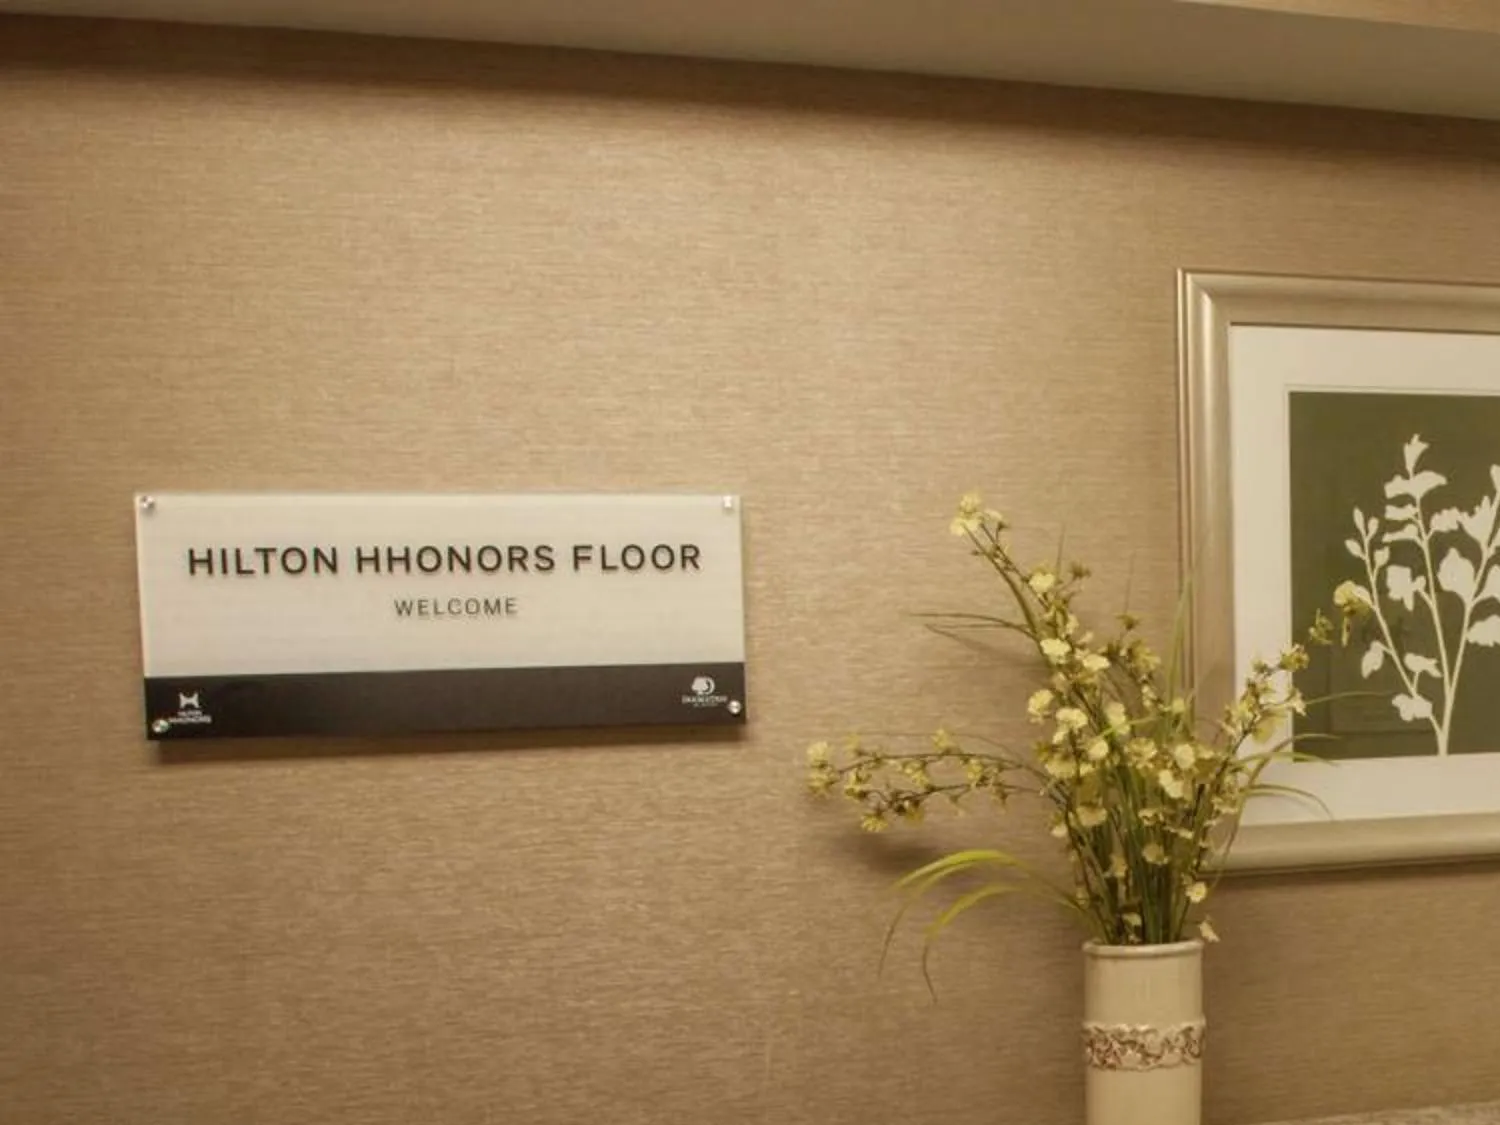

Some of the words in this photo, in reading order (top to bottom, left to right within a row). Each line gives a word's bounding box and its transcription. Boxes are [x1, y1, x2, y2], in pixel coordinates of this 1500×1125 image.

[188, 546, 338, 576] HILTON
[356, 545, 555, 574] HHONORS
[573, 544, 701, 571] FLOOR
[394, 598, 518, 617] WELCOME
